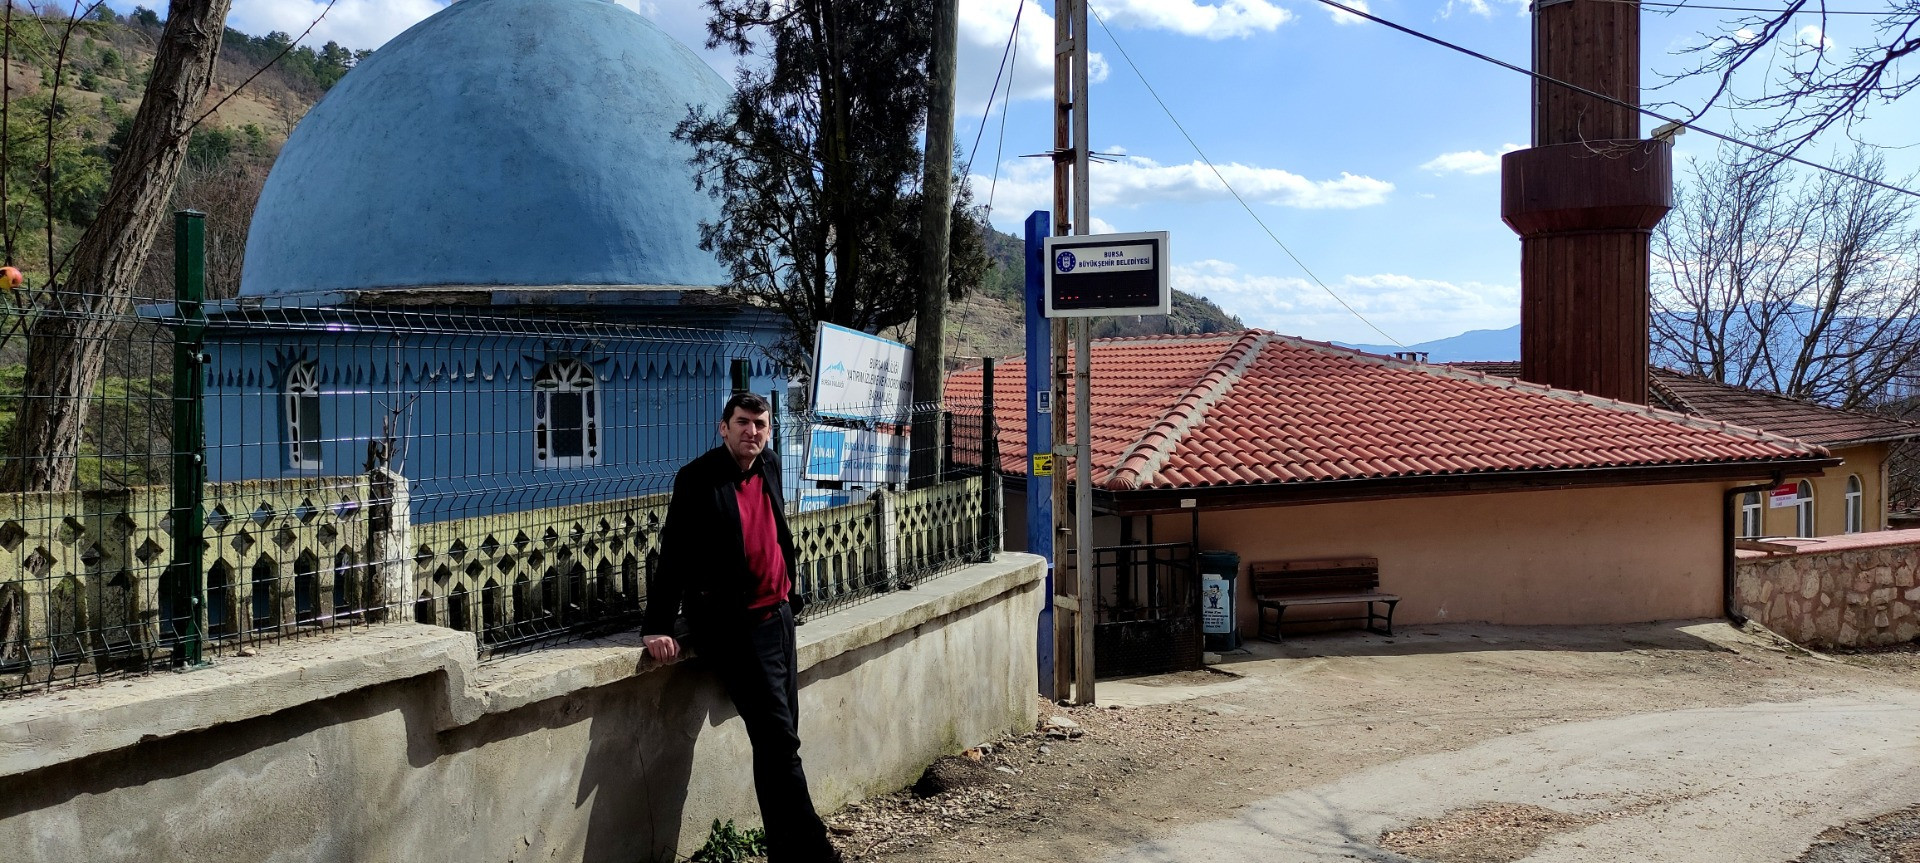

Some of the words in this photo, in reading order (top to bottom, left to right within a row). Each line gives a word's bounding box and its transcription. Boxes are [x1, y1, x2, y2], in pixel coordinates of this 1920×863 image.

[1079, 258, 1114, 268] BÜYÜKŞEHİR
[1116, 255, 1150, 266] BELEDİYESİ
[870, 358, 883, 370] BURSA
